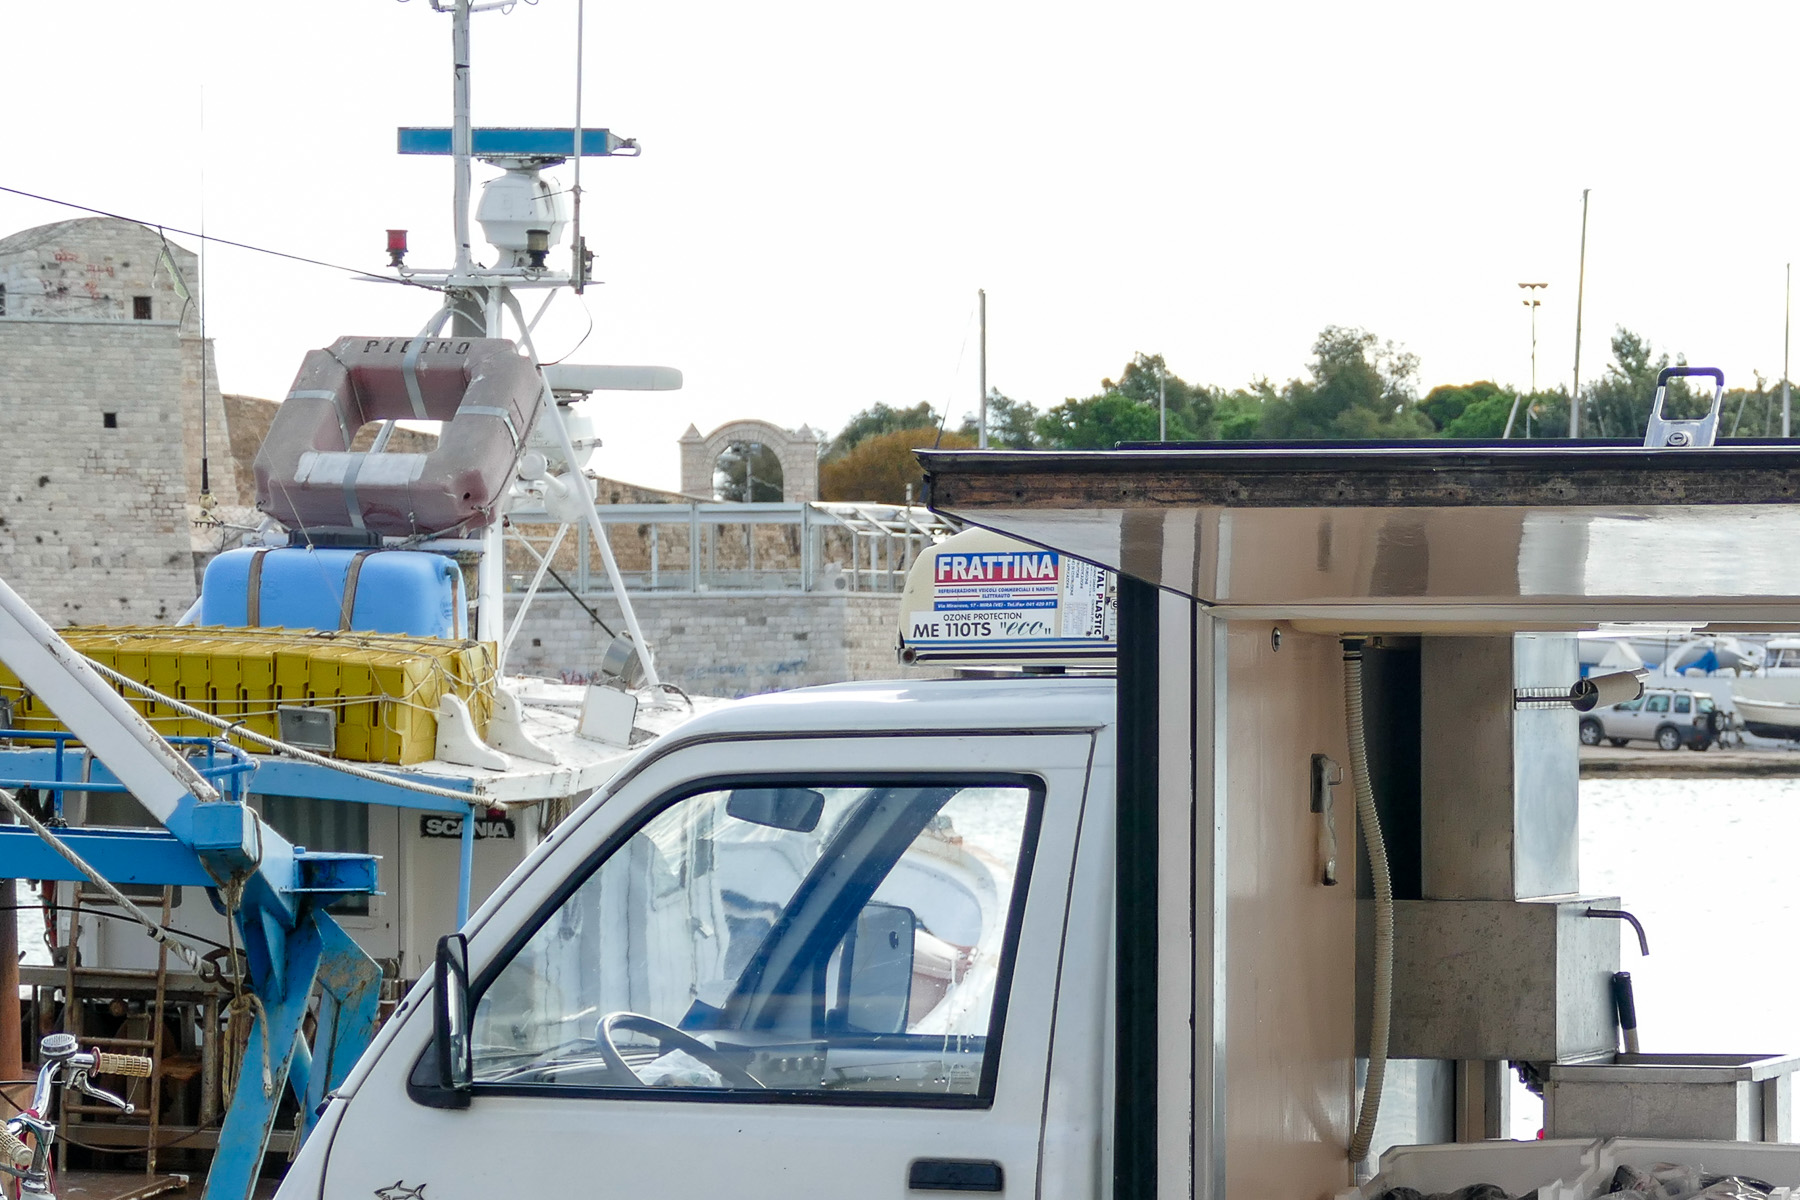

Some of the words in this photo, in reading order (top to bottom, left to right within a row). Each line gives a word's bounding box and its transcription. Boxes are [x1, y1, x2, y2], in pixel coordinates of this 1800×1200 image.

[937, 554, 1056, 580] FRATTINA
[943, 613, 971, 621] OZONE
[973, 612, 1022, 621] PROTECTION
[1094, 593, 1104, 635] PLASTIC
[913, 623, 940, 638] ME
[945, 622, 992, 637] 110TS
